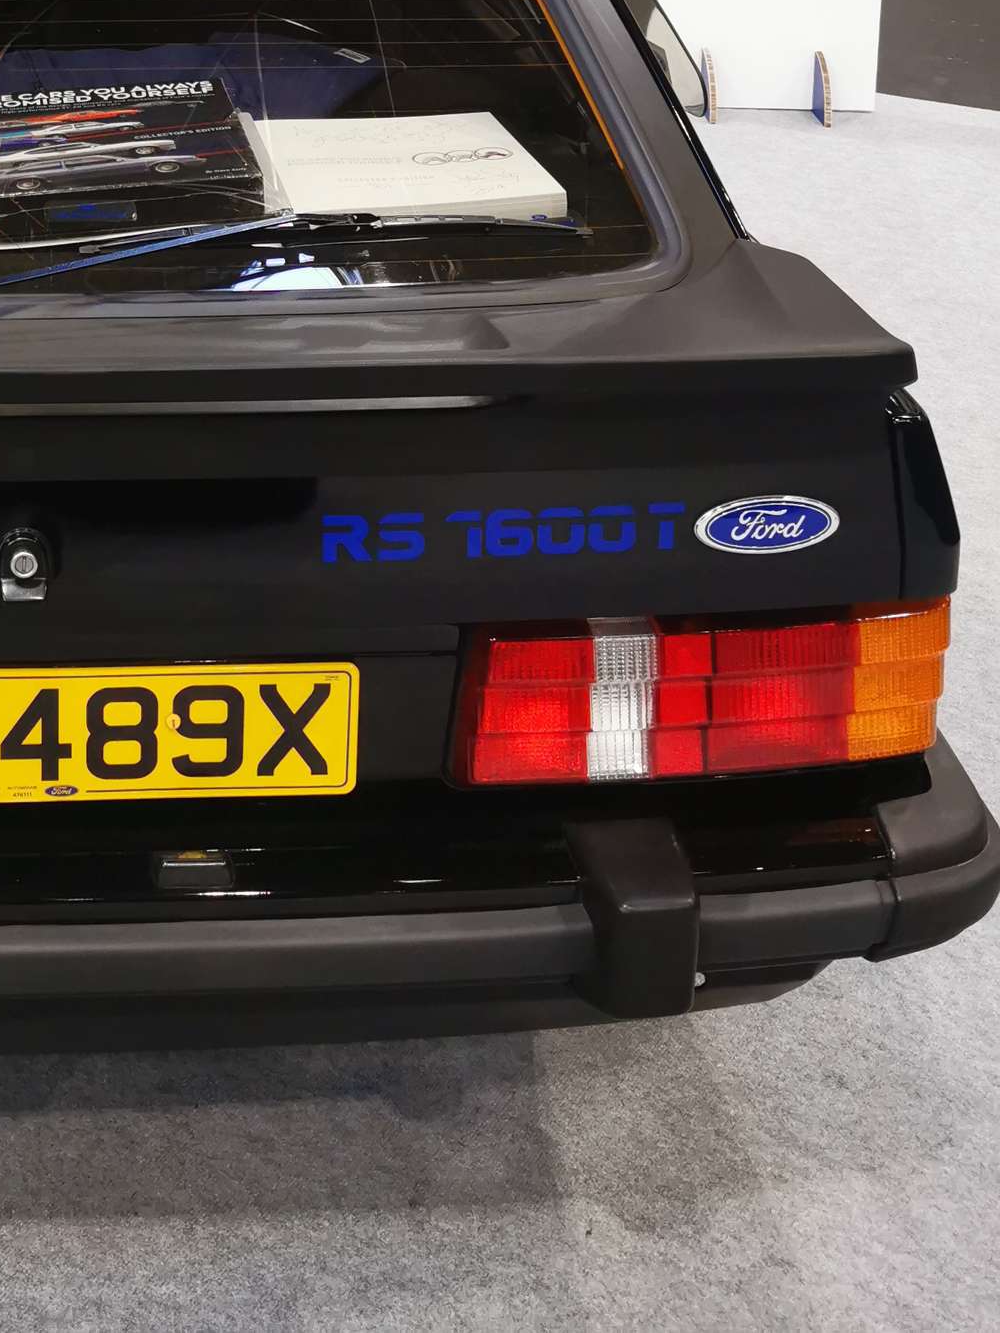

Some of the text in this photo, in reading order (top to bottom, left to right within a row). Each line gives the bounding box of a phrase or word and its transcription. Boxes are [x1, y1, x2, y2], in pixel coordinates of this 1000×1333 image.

[18, 90, 76, 103] CARS
[81, 86, 125, 99] YOU
[131, 80, 212, 95] ALWAYS
[97, 86, 214, 103] YOURSELF
[134, 126, 231, 140] COLLECTOR'S EDITION
[731, 509, 803, 542] Ford
[322, 513, 425, 562] RS
[0, 683, 332, 781] 489X
[51, 786, 73, 796] Ford
